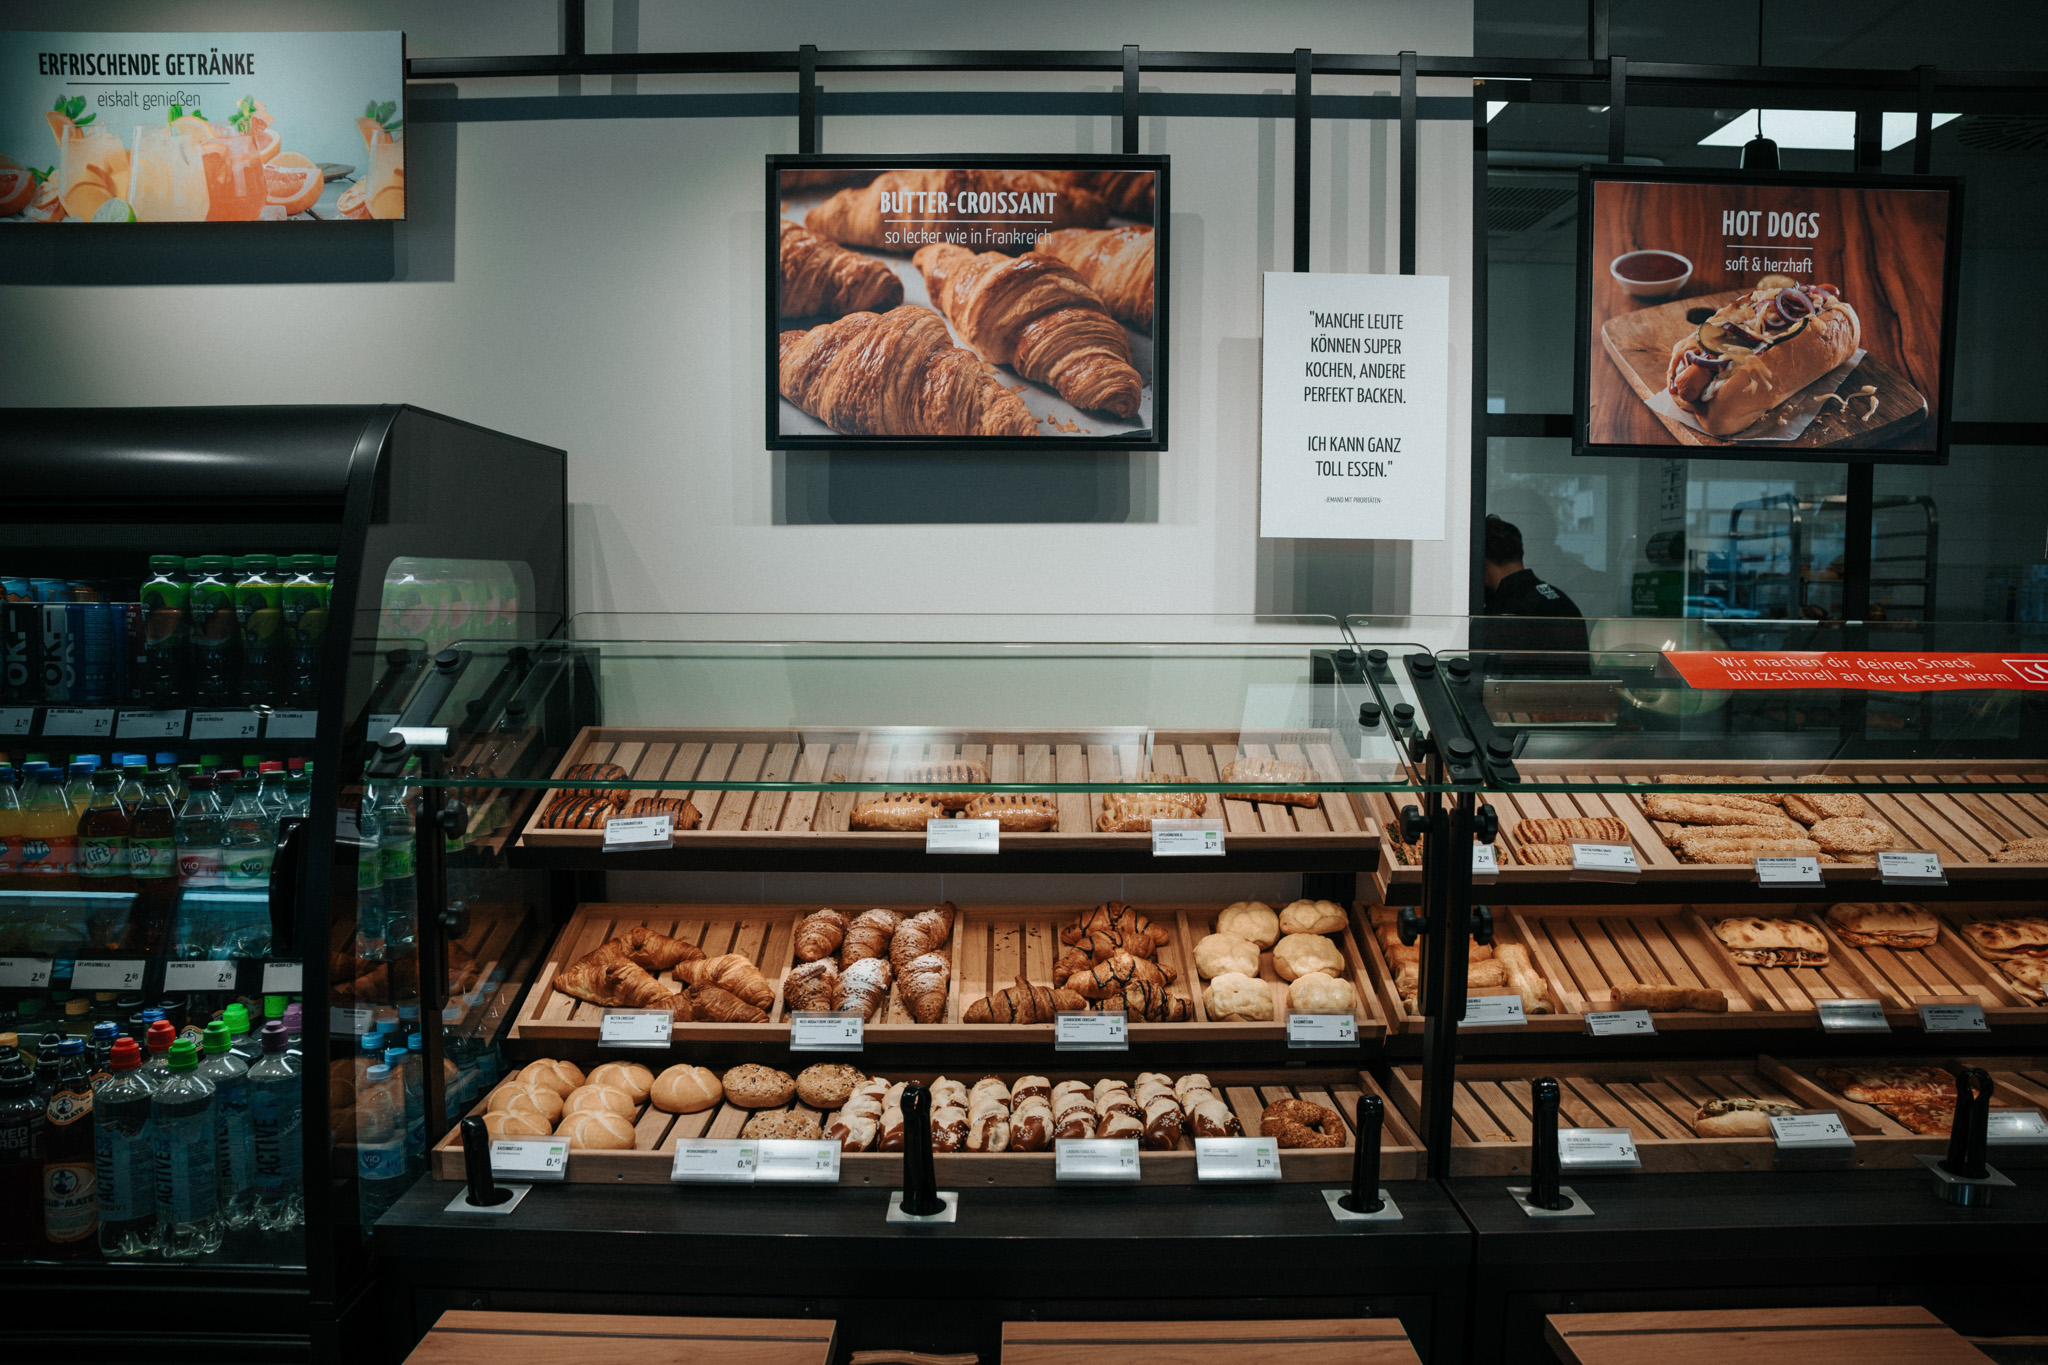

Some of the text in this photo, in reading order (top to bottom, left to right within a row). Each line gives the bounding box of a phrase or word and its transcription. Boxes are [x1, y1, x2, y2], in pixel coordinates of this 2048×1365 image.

[38, 47, 255, 76] ERFRISCHENDE GETRÄNKE
[97, 90, 201, 110] eiskalt genießen
[879, 191, 1058, 215] BUTTER-CROISSANT
[1722, 210, 1820, 239] HOT DOGS
[884, 227, 1052, 246] so lecker wie in Frankreich
[1725, 256, 1813, 274] soft & herzhaft
[1309, 310, 1404, 330] "MANCHE LEUTE
[1310, 333, 1402, 355] KÖNNEN SUPER
[1305, 362, 1406, 380] KOCHEN, ANDERE
[1304, 386, 1407, 404] PERFEKT BACKEN.
[1307, 436, 1401, 453] ICH KANN GANZ
[1315, 460, 1393, 477] TOLL ESSEN."
[1713, 656, 1976, 670] Wir machen dir deinen Snack
[1726, 668, 2013, 684] blitzschnell an der Kasse warm
